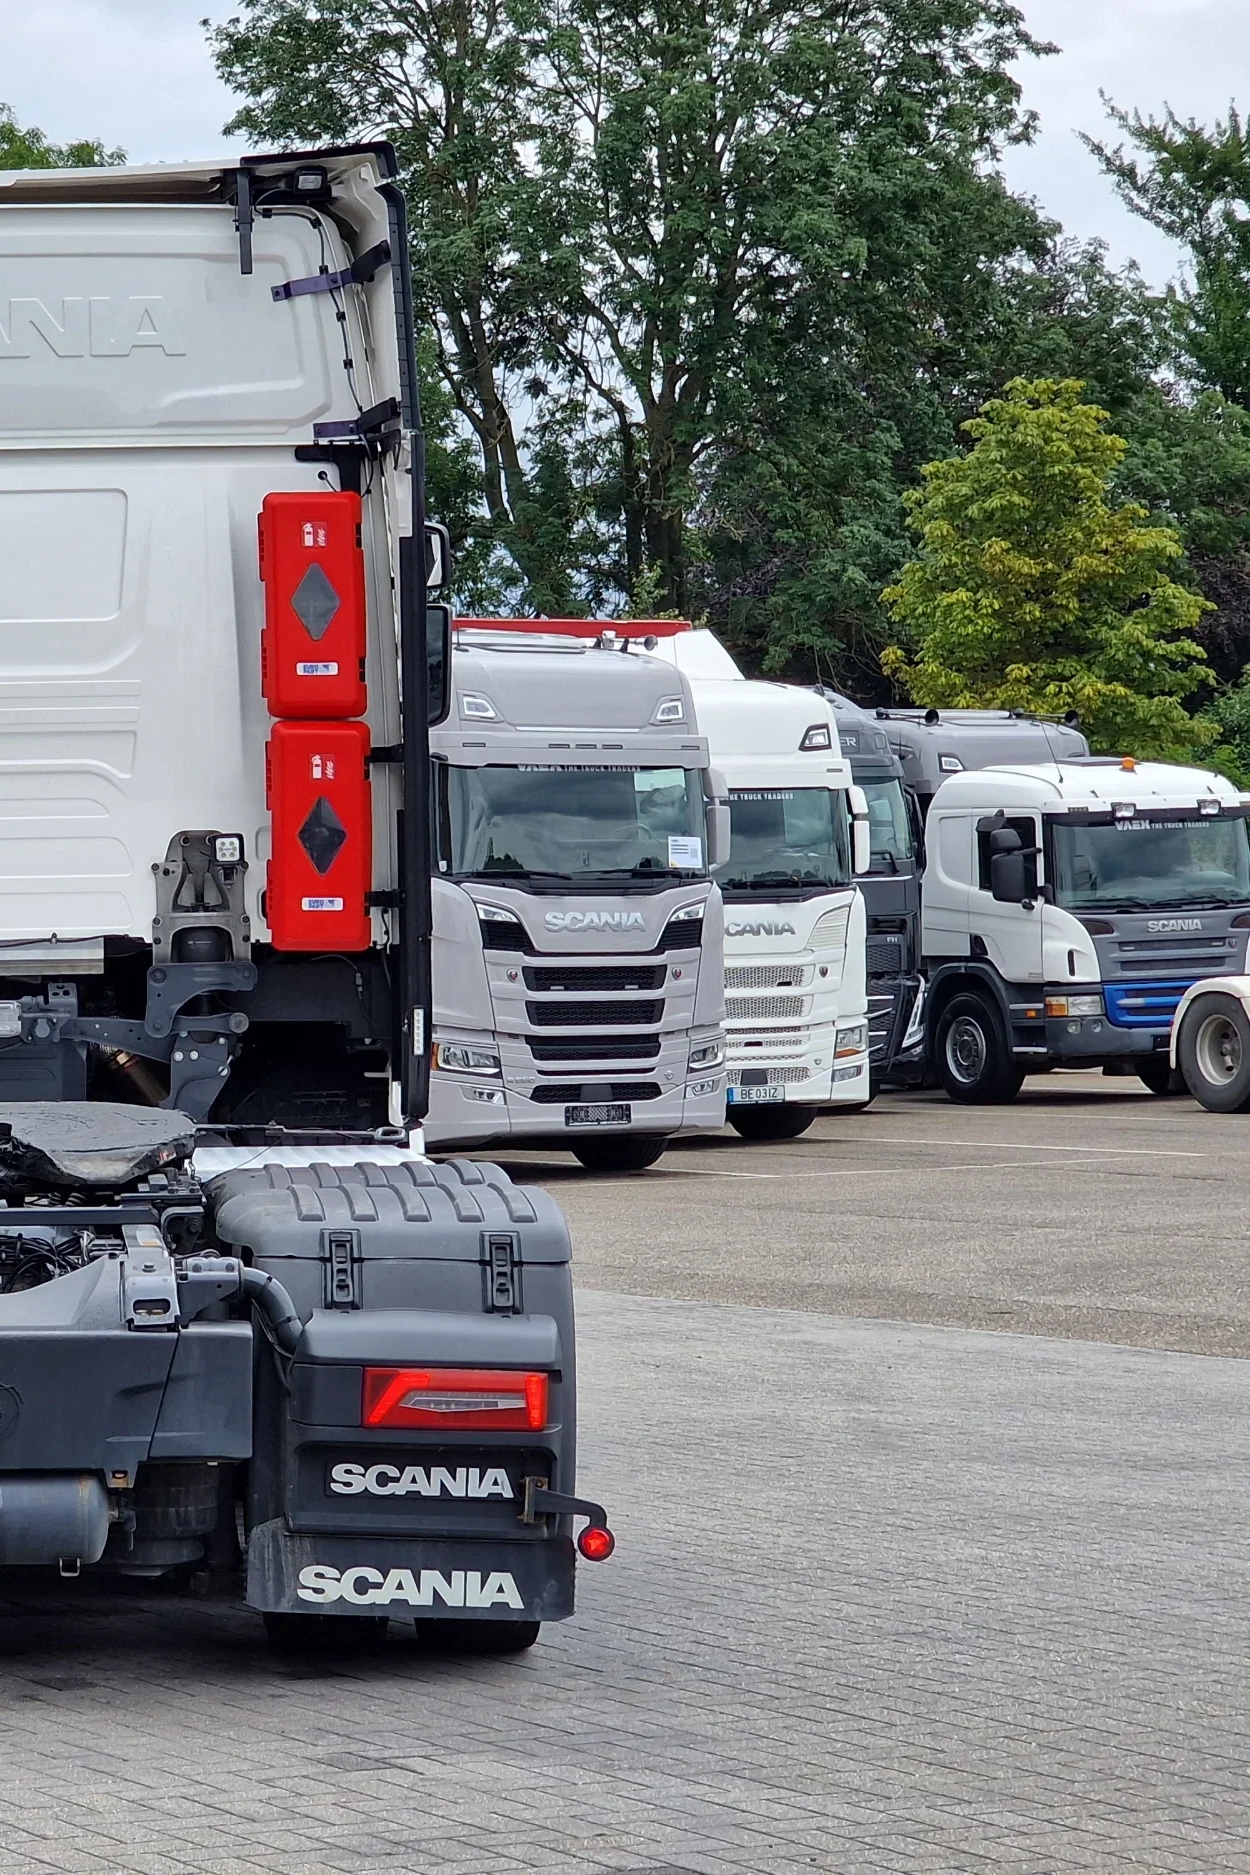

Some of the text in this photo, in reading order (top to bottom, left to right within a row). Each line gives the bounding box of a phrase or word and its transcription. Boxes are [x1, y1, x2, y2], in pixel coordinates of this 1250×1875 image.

[764, 792, 794, 800] TRADERS
[544, 911, 647, 933] SCANIA
[724, 919, 796, 937] CANIA
[1147, 918, 1203, 932] SCANIA
[329, 1463, 515, 1498] SCANIA
[296, 1565, 525, 1609] SCANIA
